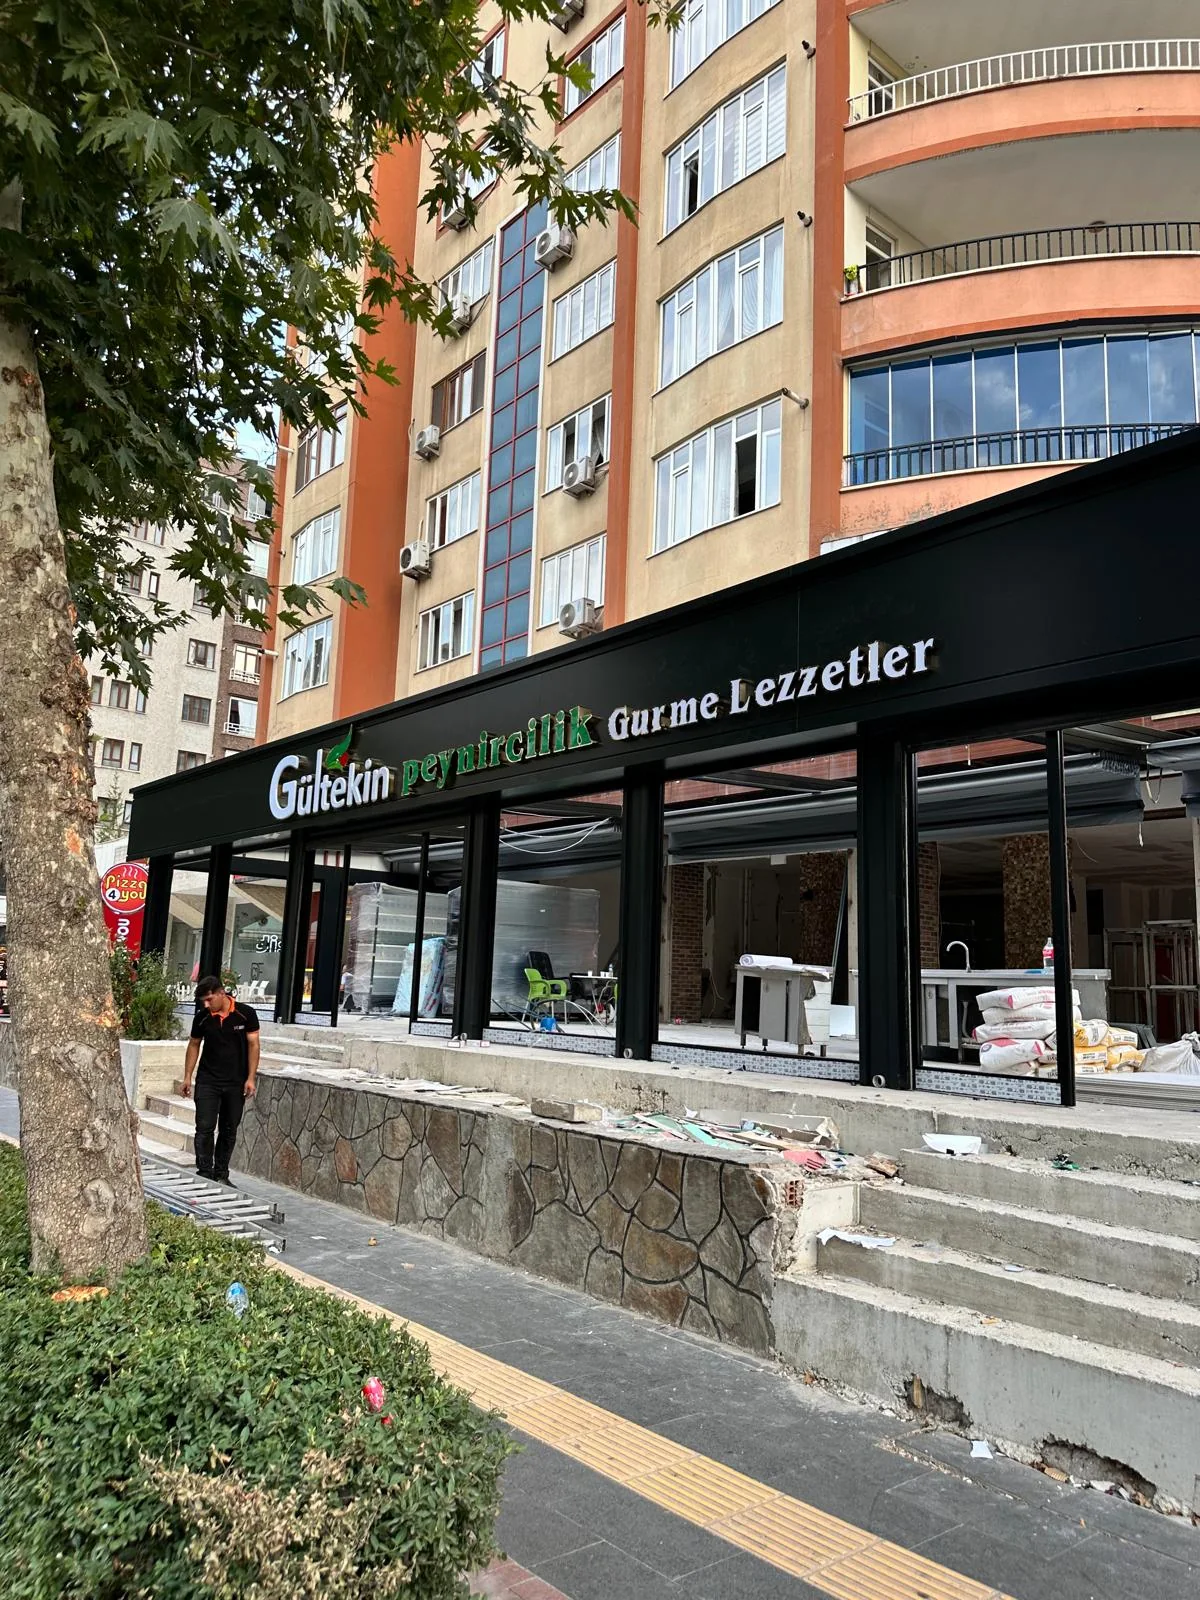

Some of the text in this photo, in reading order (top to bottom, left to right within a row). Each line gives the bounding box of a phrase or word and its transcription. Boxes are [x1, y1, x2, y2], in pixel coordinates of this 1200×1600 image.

[269, 637, 935, 820] Gültekin peynircilik Gurme Lezzetler
[105, 875, 147, 889] Pizza
[118, 890, 147, 902] you
